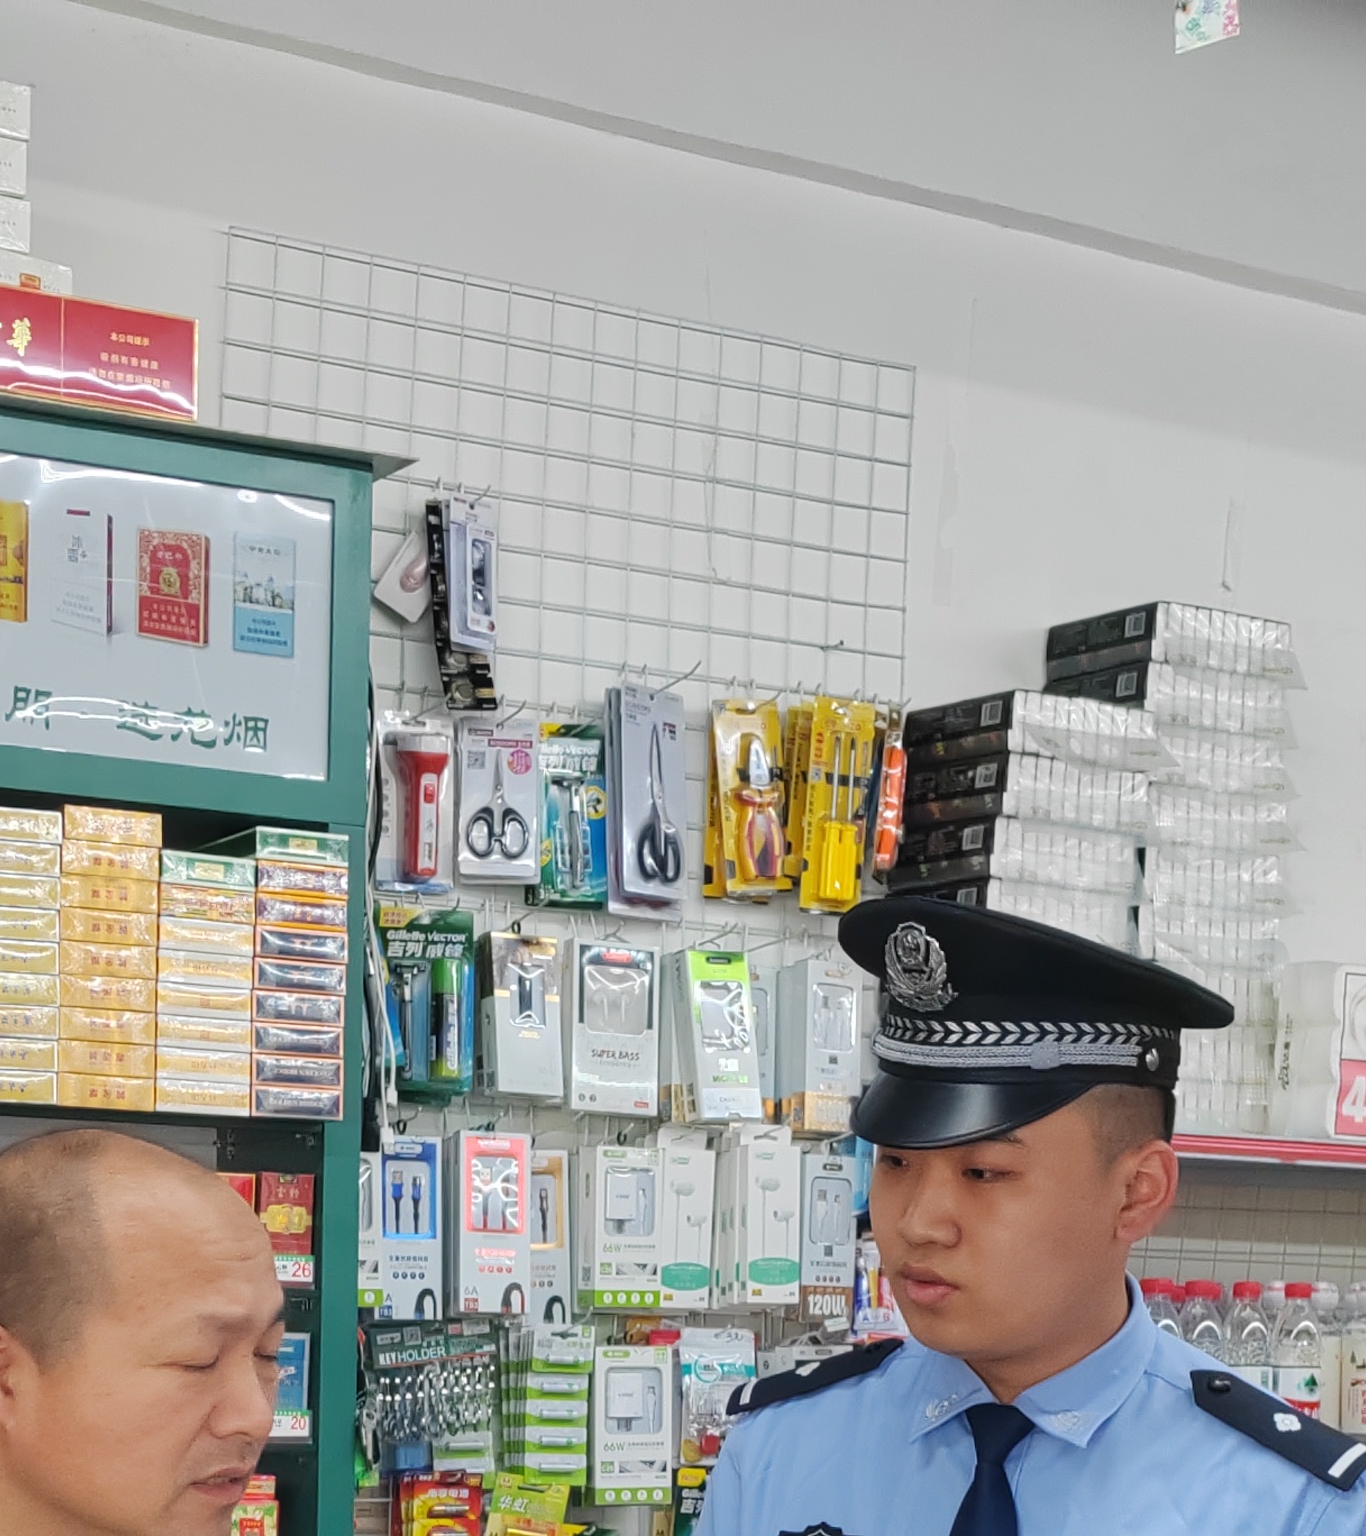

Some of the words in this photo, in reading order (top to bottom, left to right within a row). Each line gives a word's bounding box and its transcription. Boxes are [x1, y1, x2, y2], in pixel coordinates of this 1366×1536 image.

[385, 928, 426, 941] Gillette
[427, 931, 467, 942] VECTOR
[591, 1048, 617, 1060] SUPER
[618, 1049, 640, 1061] BASS
[291, 1262, 312, 1278] 26
[289, 1416, 308, 1430] 20
